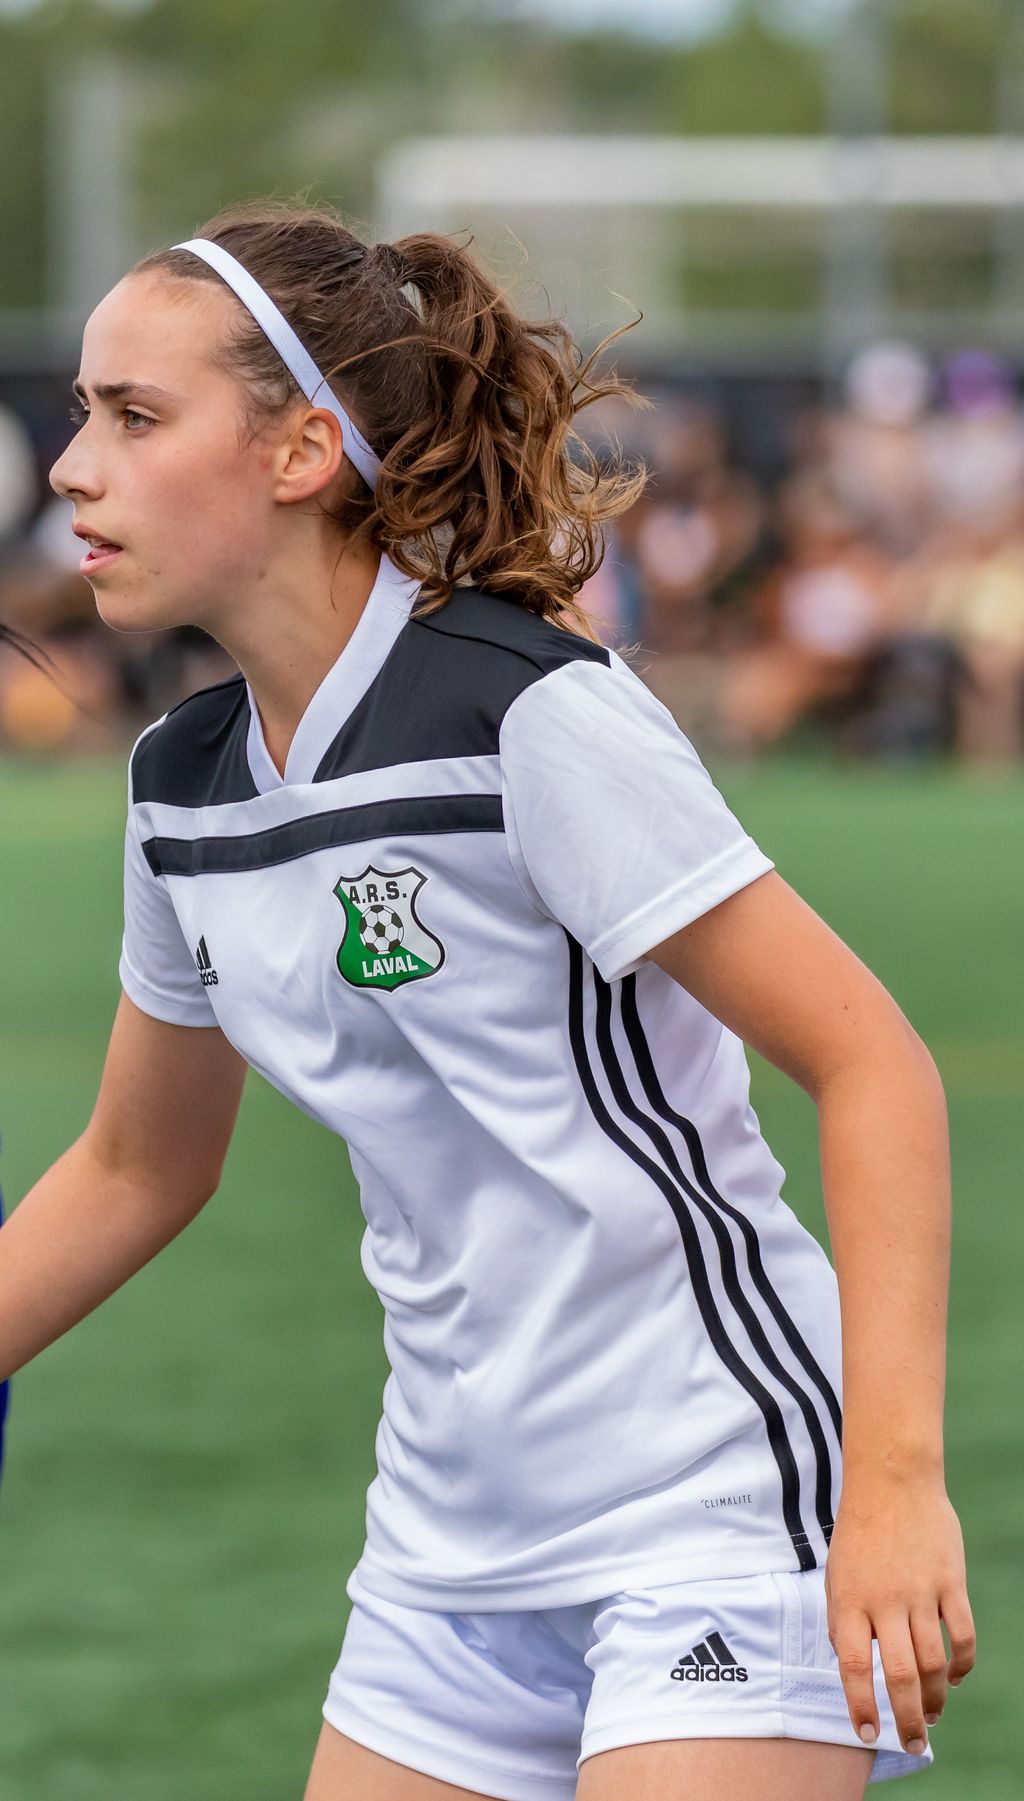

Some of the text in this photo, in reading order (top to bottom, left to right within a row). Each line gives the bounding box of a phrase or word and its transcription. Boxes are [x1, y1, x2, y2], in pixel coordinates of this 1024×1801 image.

[349, 881, 407, 905] A.R.S.
[362, 954, 419, 978] LAVAL
[702, 1494, 752, 1509] CLIMALITE
[670, 1664, 748, 1683] adidas
